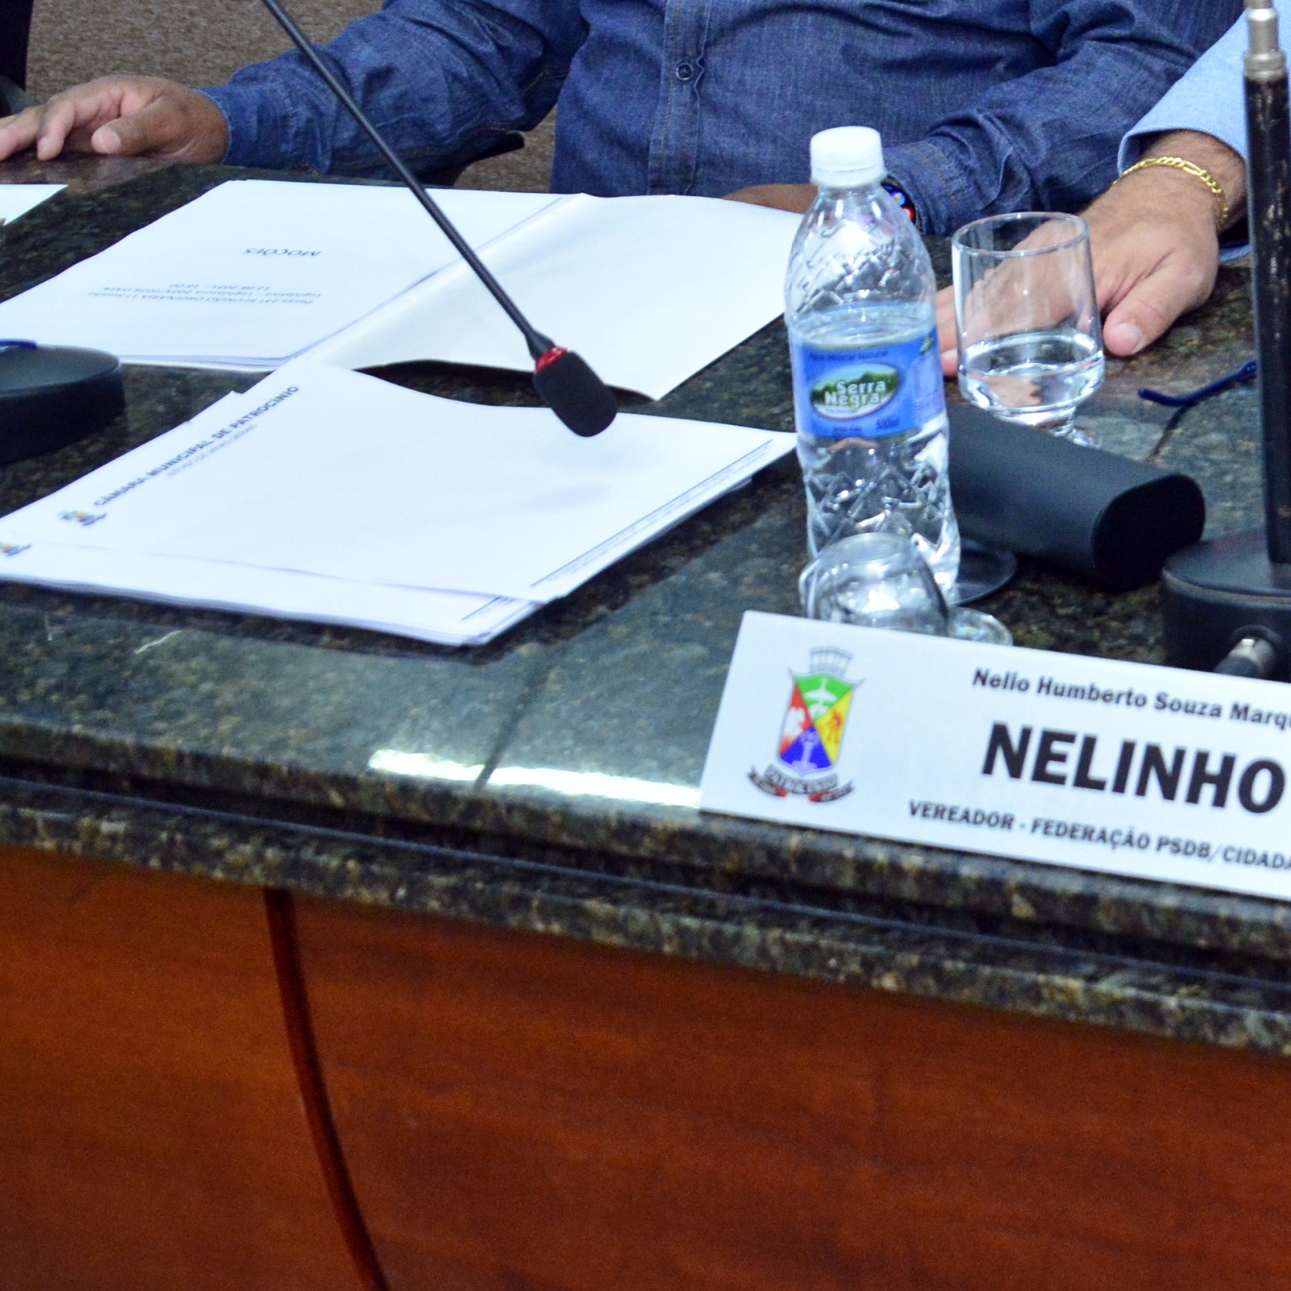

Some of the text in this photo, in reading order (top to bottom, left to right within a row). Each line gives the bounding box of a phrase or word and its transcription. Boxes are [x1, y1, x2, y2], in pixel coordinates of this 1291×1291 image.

[824, 391, 881, 409] Negra
[836, 379, 887, 395] Serra
[147, 438, 214, 477] MUNICIPAL
[212, 427, 231, 440] DE
[229, 385, 300, 430] PATROCÍNIO
[972, 667, 1030, 693] Nelio
[1036, 675, 1148, 709] Humberto
[1153, 691, 1223, 719] Souza
[981, 720, 1287, 815] NELINHO
[907, 799, 1015, 831] VEREADOR
[1031, 817, 1150, 850] FEDERAÇÃO
